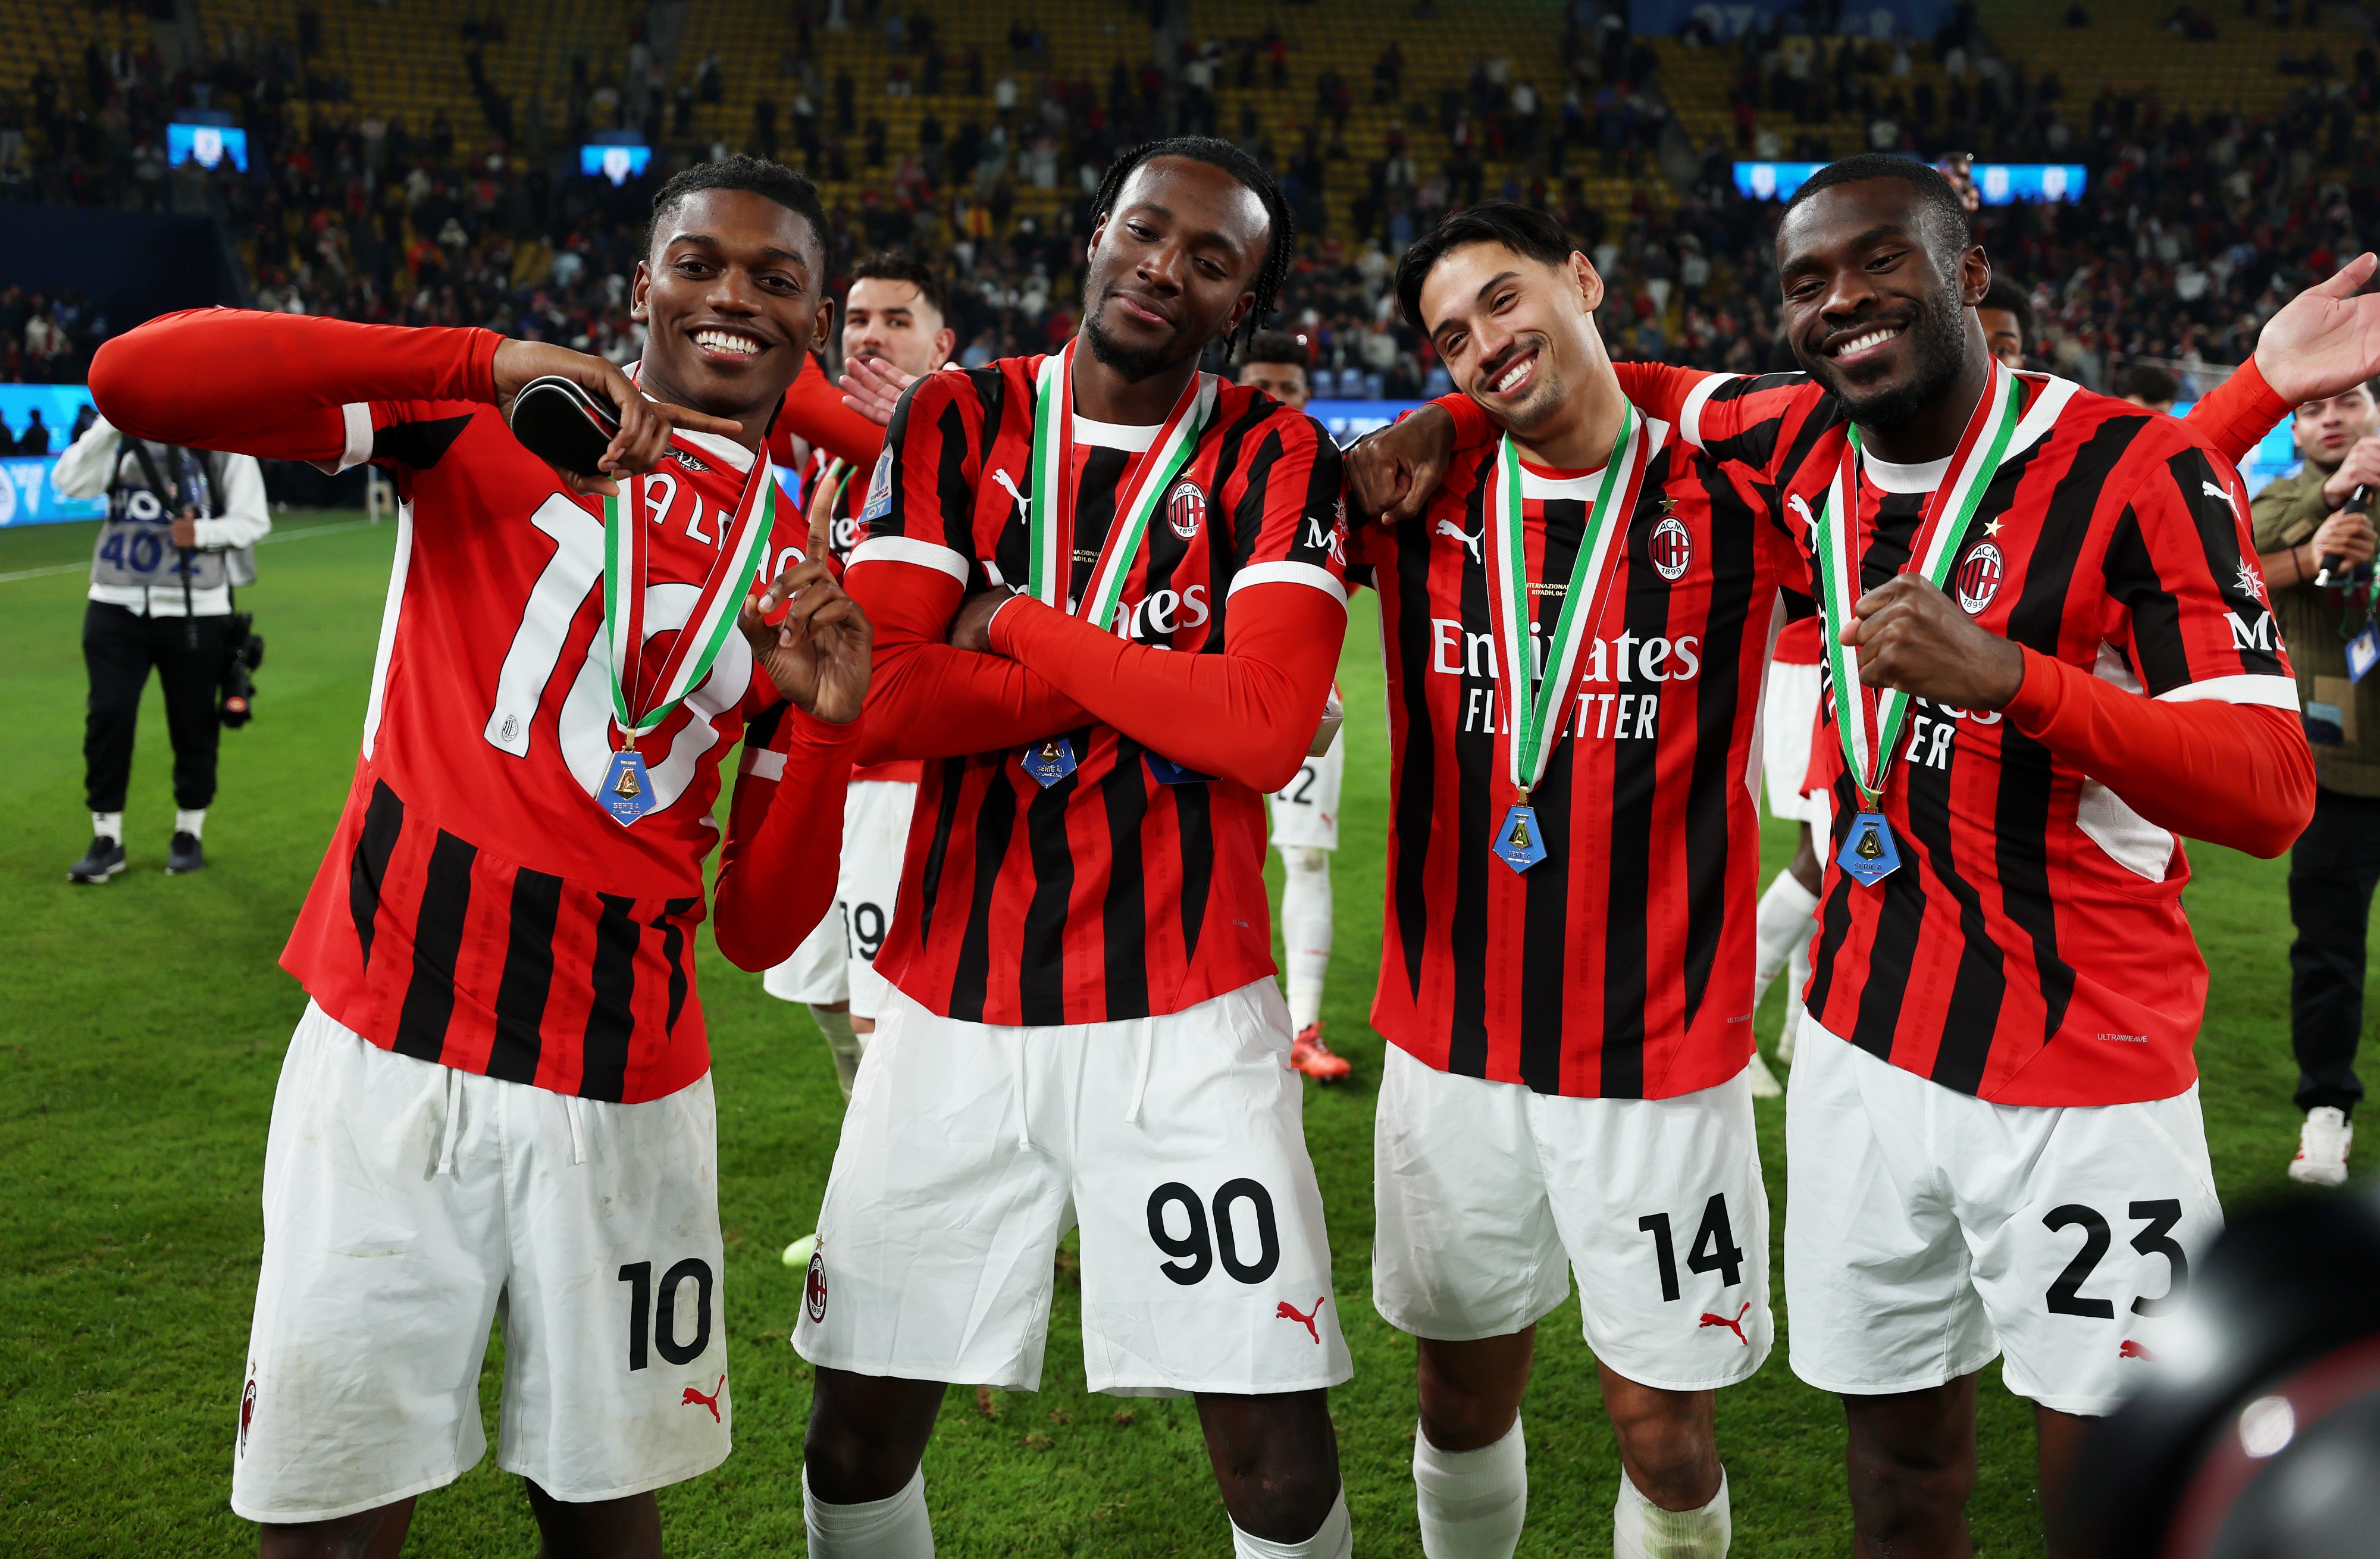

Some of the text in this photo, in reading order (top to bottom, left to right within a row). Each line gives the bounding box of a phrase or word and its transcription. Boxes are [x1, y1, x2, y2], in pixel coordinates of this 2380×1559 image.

[870, 486, 888, 501] SUPERCUP
[1176, 485, 1199, 497] ACM
[1658, 520, 1683, 533] ACM
[1972, 546, 1998, 562] ACM
[1964, 599, 1984, 608] 1899
[484, 492, 753, 816] 10
[1431, 618, 1700, 683] Emiates
[839, 901, 885, 961] 19
[2097, 1033, 2148, 1043] ULTRAWEAVE
[1147, 1178, 1280, 1286] 90
[1639, 1192, 1744, 1302] 14
[2041, 1198, 2189, 1320] 23
[618, 1257, 713, 1372] 10
[811, 1304, 822, 1314] 1899
